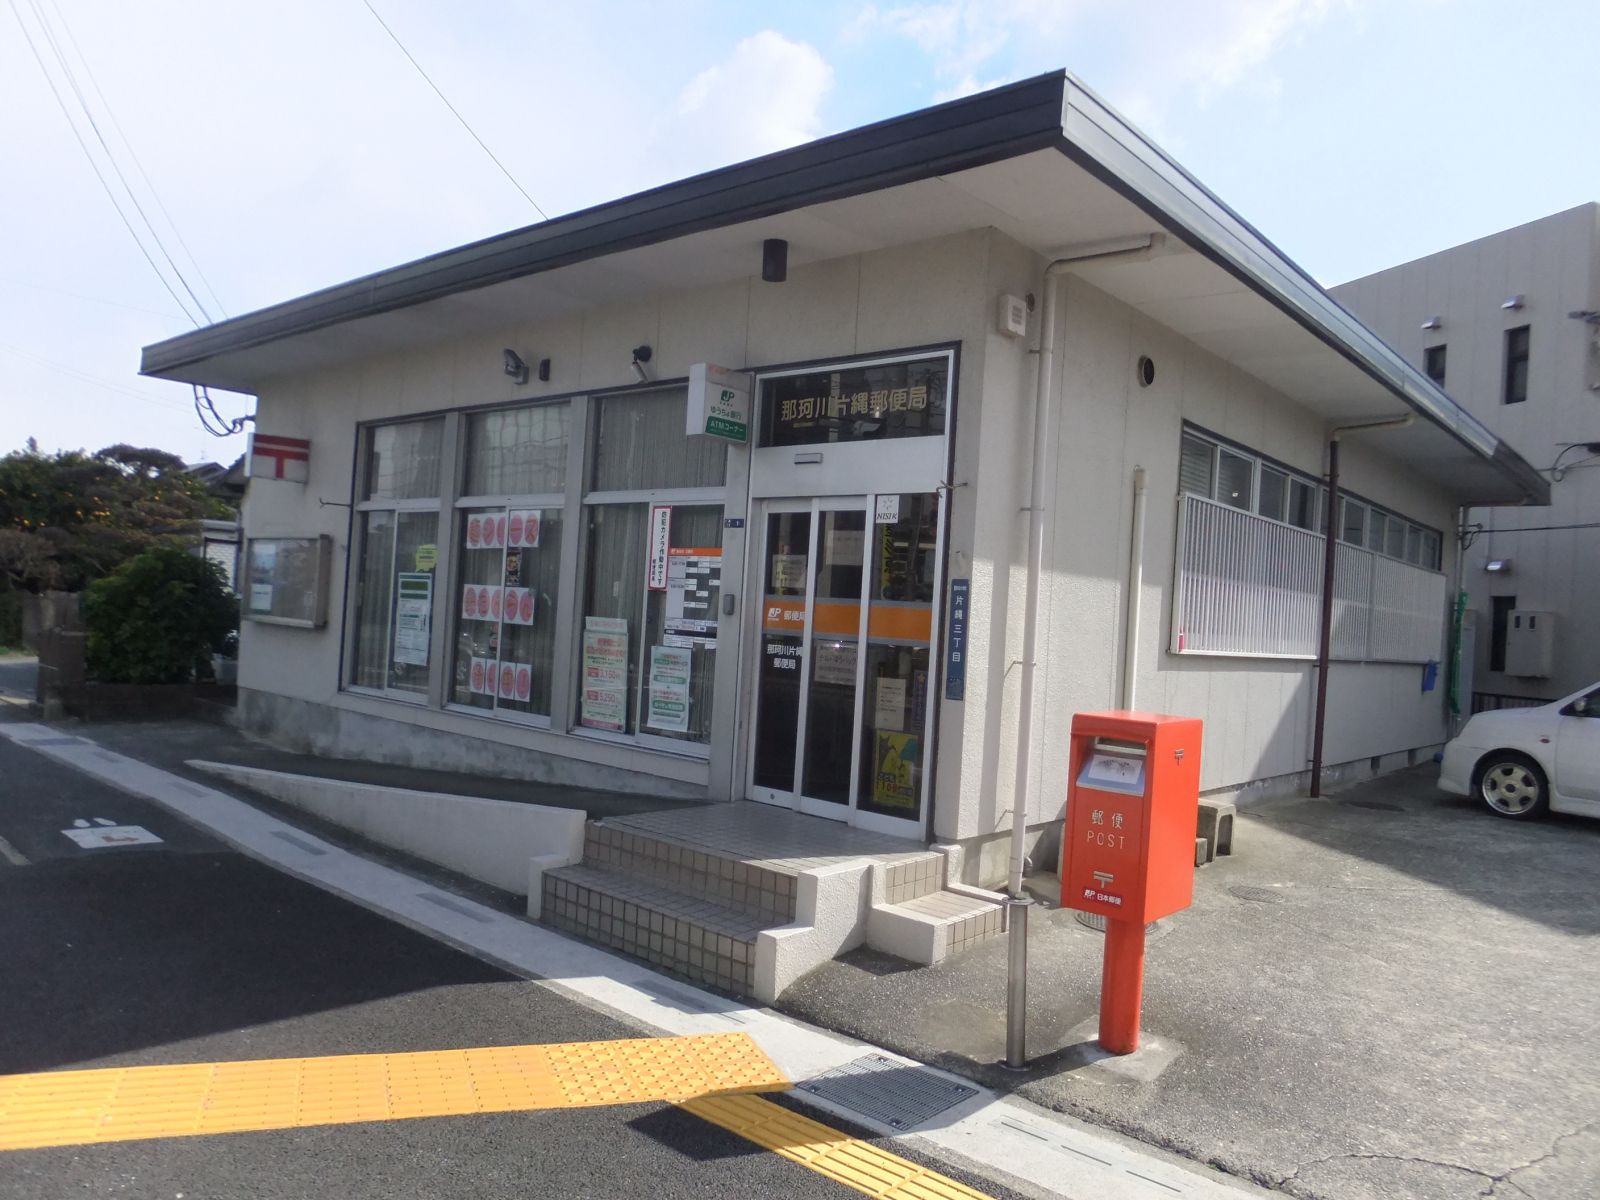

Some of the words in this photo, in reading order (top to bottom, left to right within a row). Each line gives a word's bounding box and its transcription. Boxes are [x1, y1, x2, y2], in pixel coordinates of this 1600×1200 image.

[781, 386, 927, 421] 那珂川片縄郵便局
[1092, 809, 1123, 829] 郵便
[1087, 830, 1125, 849] POST
